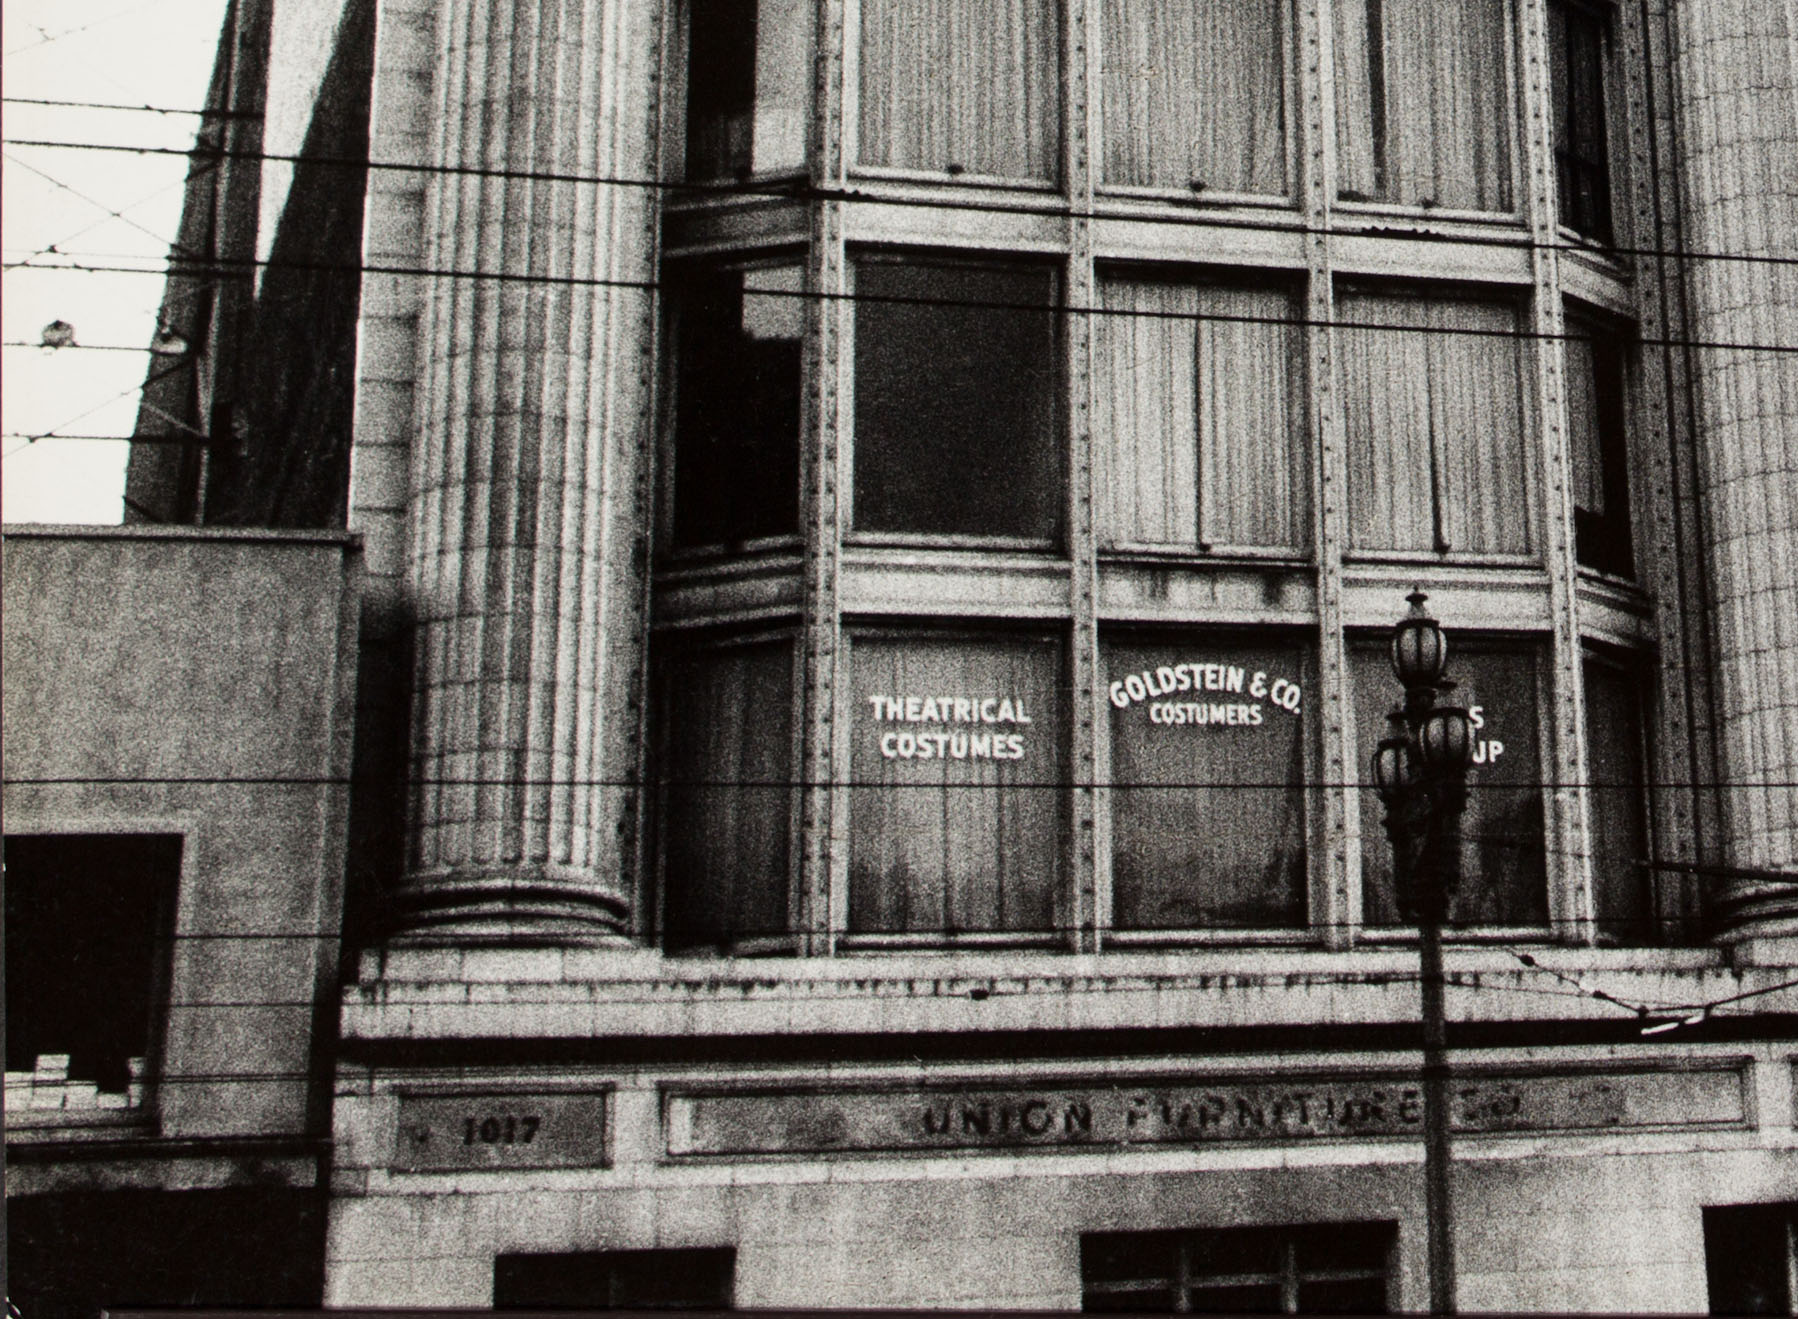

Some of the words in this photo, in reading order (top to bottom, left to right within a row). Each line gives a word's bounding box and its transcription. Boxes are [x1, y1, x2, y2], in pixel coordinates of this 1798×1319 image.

[1109, 662, 1245, 709] GOLDSTEIN
[1249, 670, 1268, 699] &
[1270, 678, 1302, 715] CO.
[868, 694, 1032, 723] THEATRICAL
[1150, 702, 1263, 726] COSTUMERS
[880, 732, 1025, 760] COSTUMES
[463, 1116, 541, 1146] 1017
[922, 1098, 1093, 1136] UNION
